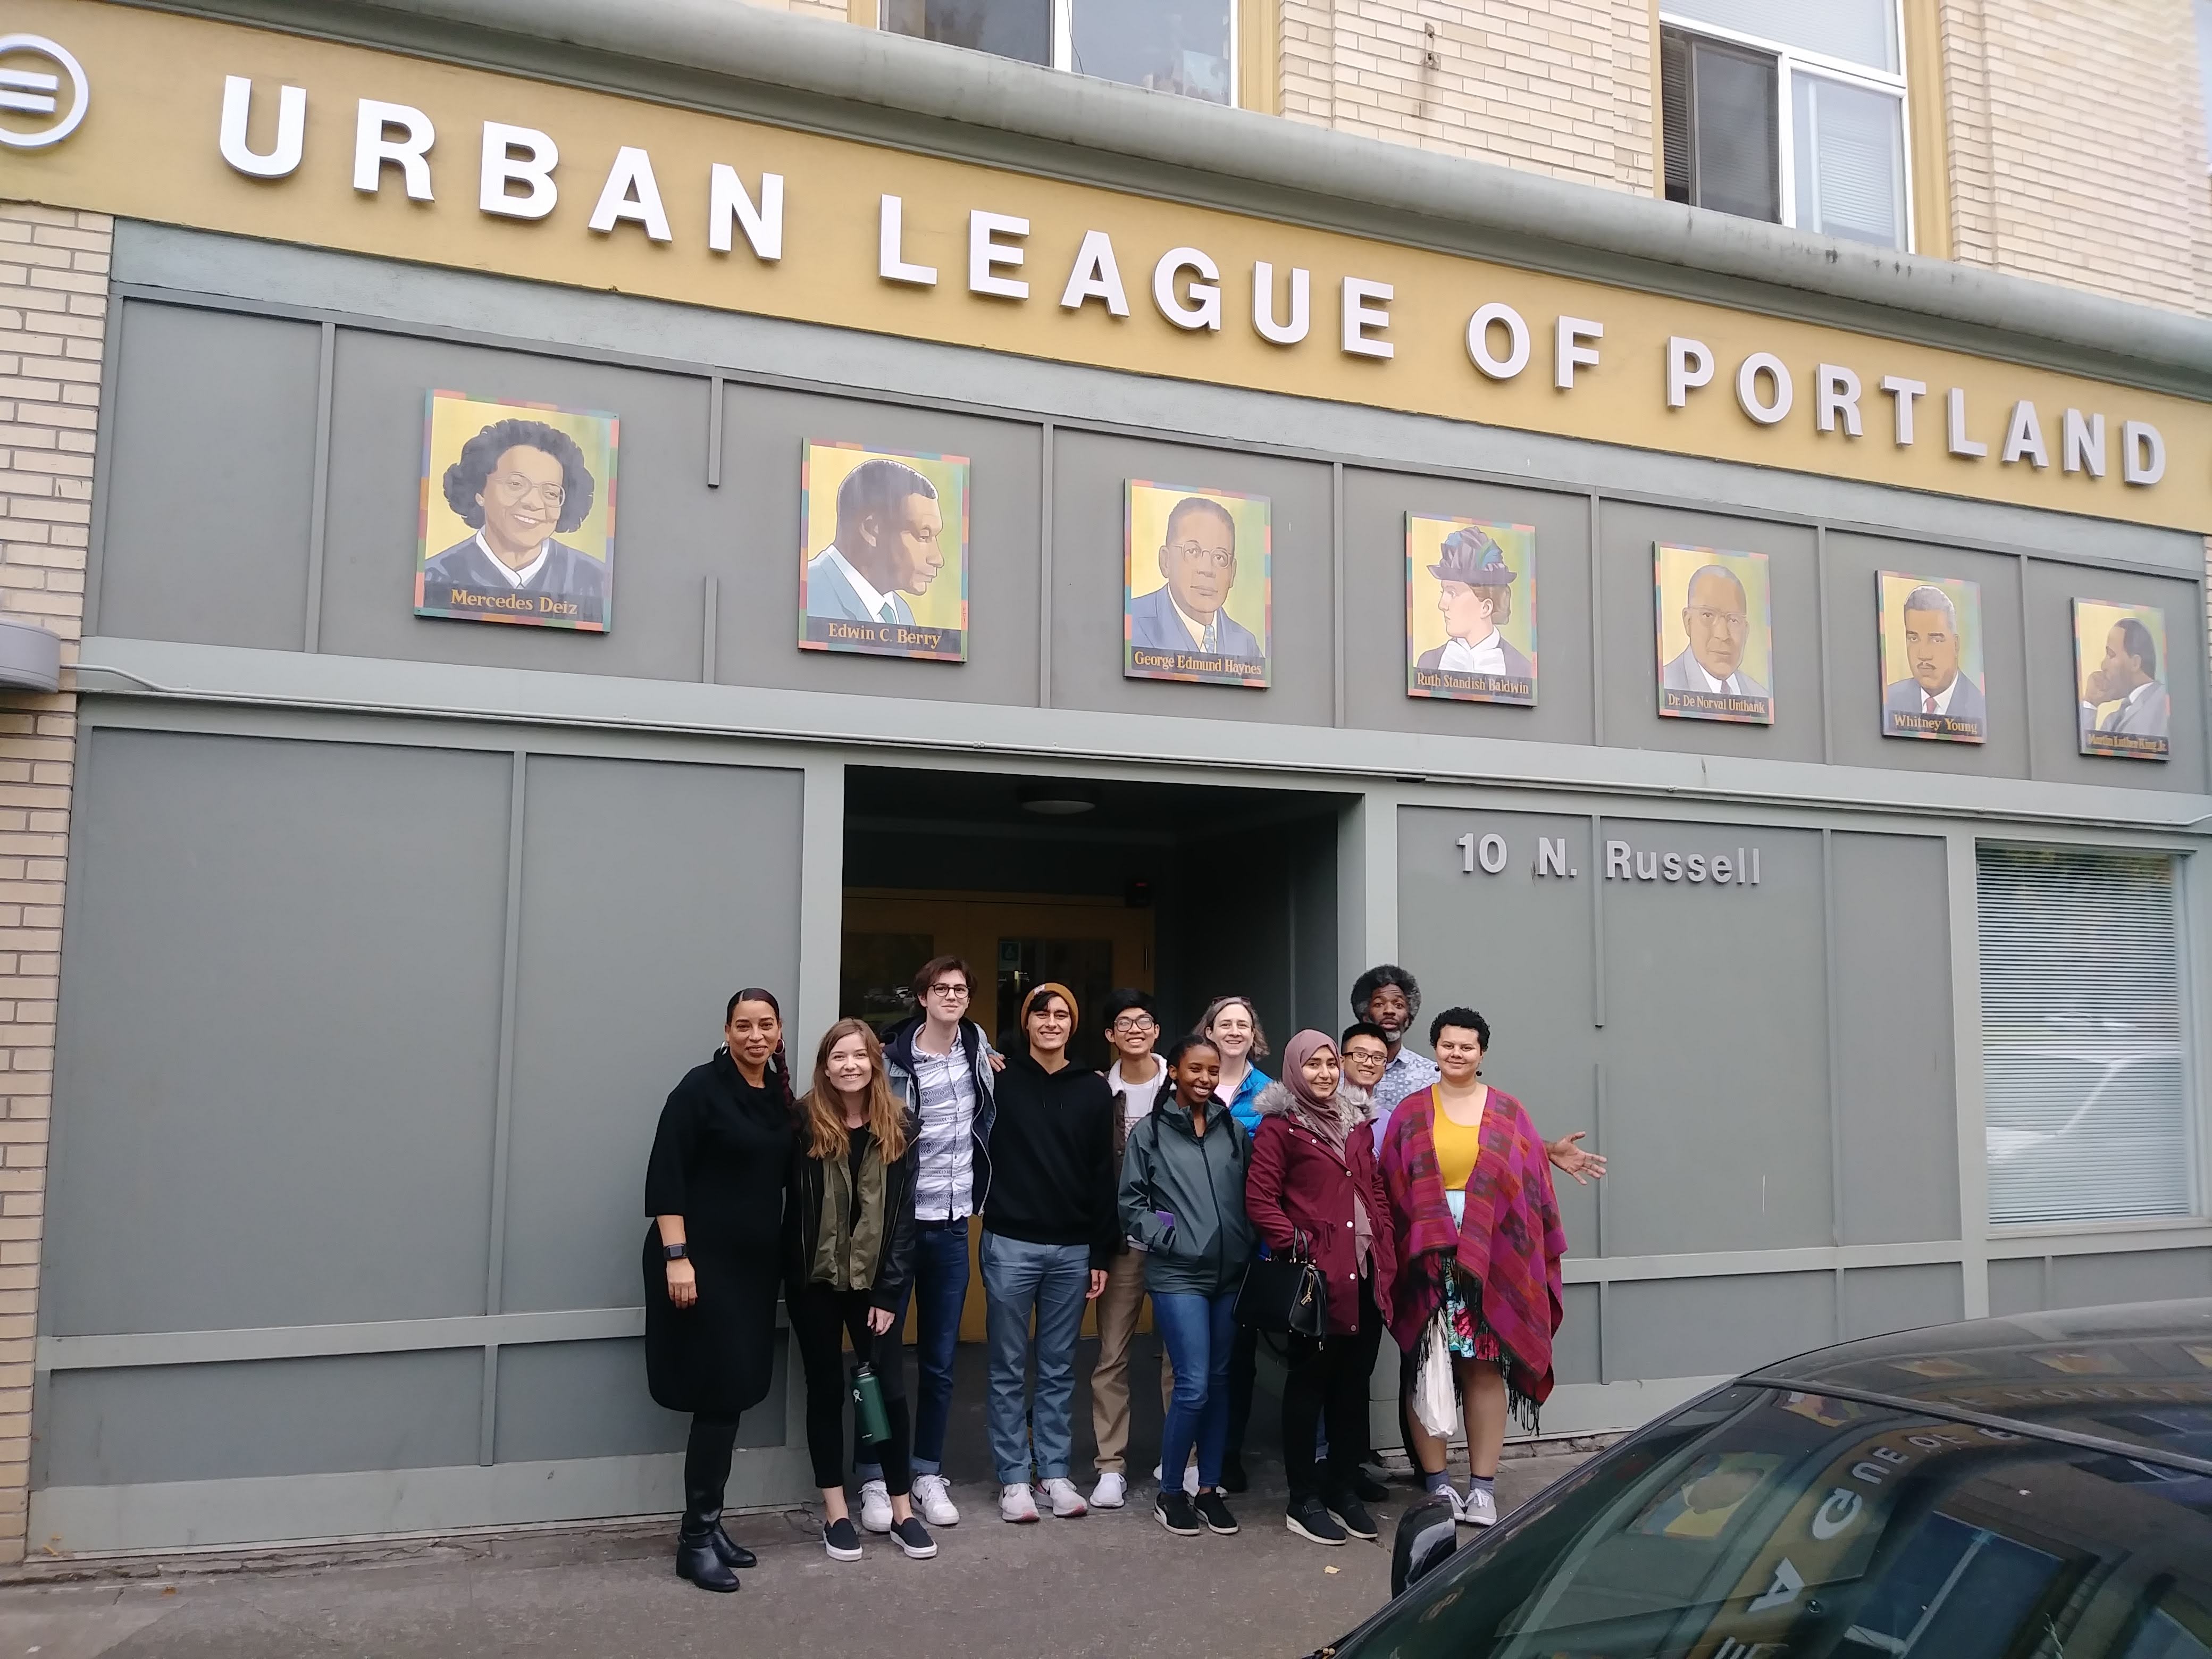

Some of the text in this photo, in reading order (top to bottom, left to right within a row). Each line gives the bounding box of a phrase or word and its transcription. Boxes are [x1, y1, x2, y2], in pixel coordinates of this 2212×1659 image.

[220, 76, 2166, 485] URBAN LEAGUE OF PORTLAND
[451, 589, 577, 615] Mercedes Deiz
[828, 623, 941, 649] Edwin C. Berry
[1134, 651, 1262, 675] George Edmund Haynes
[1417, 672, 1529, 694] Ruth Standish Baldwin
[1668, 693, 1765, 714] Dr. De Norval Unthank
[1894, 714, 1978, 734] Whitney Young
[1457, 833, 1760, 884] 10 N. Russell
